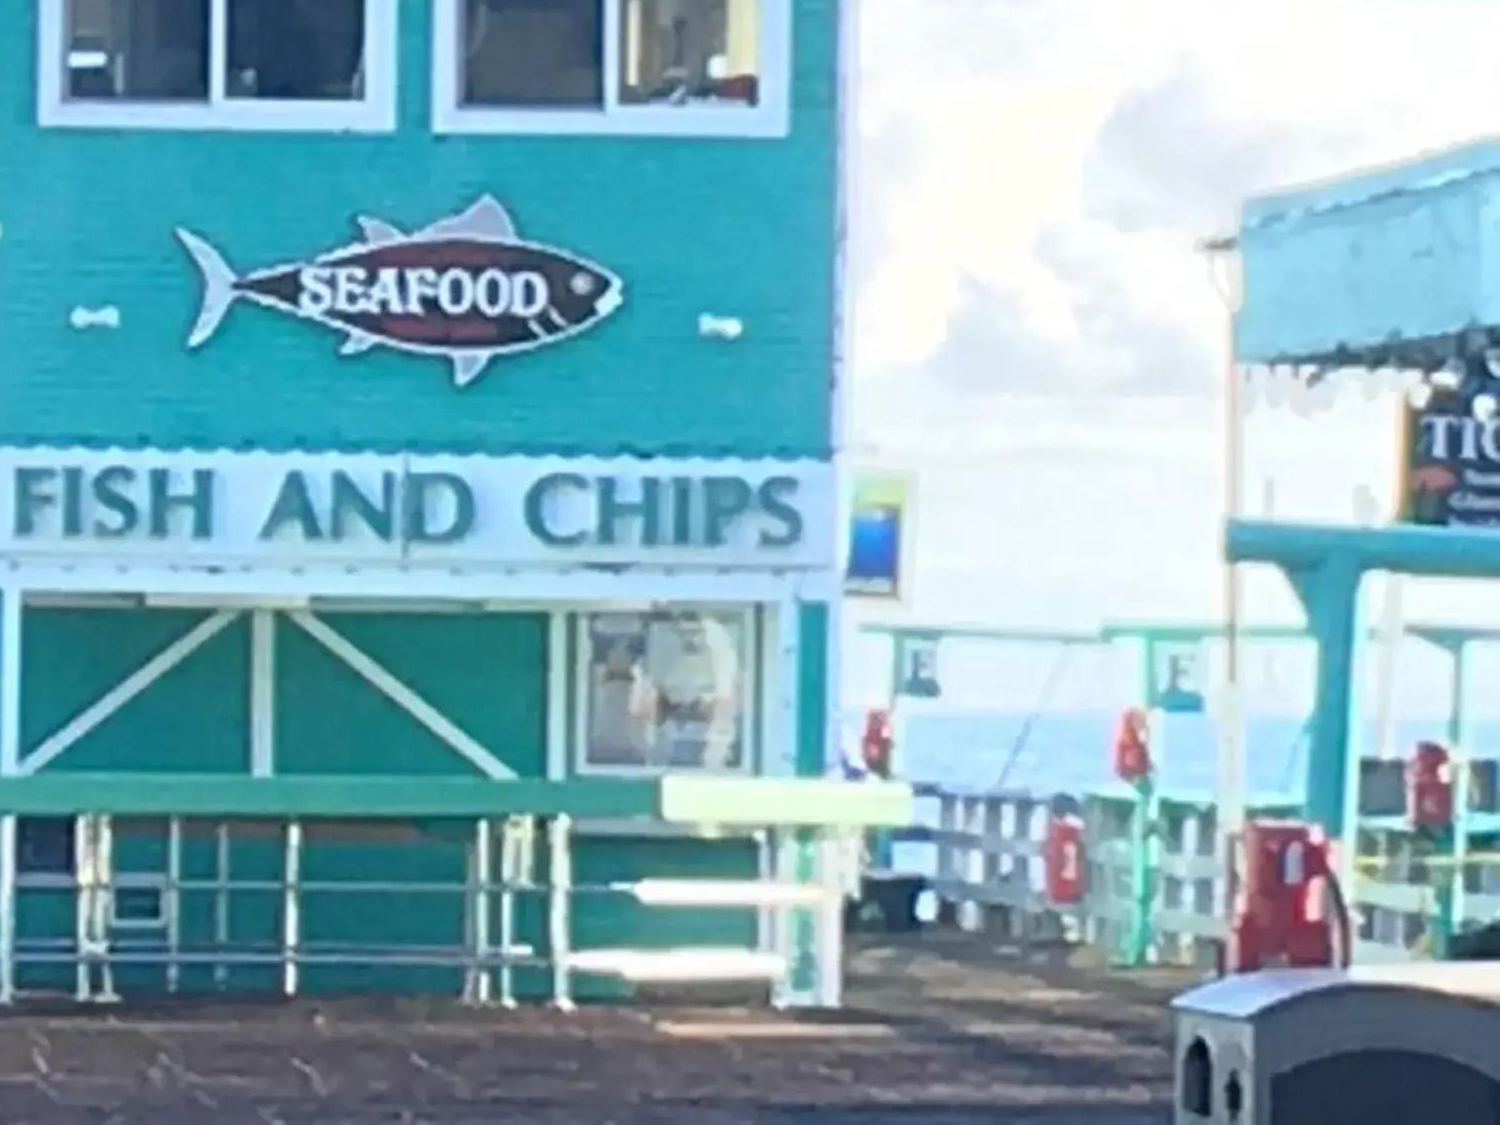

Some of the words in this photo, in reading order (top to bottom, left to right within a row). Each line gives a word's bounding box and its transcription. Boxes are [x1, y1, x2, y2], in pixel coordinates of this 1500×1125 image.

[299, 266, 548, 317] SEAFOOD
[13, 465, 216, 540] FISH
[256, 469, 476, 545] AND
[523, 472, 804, 547] CHIPS
